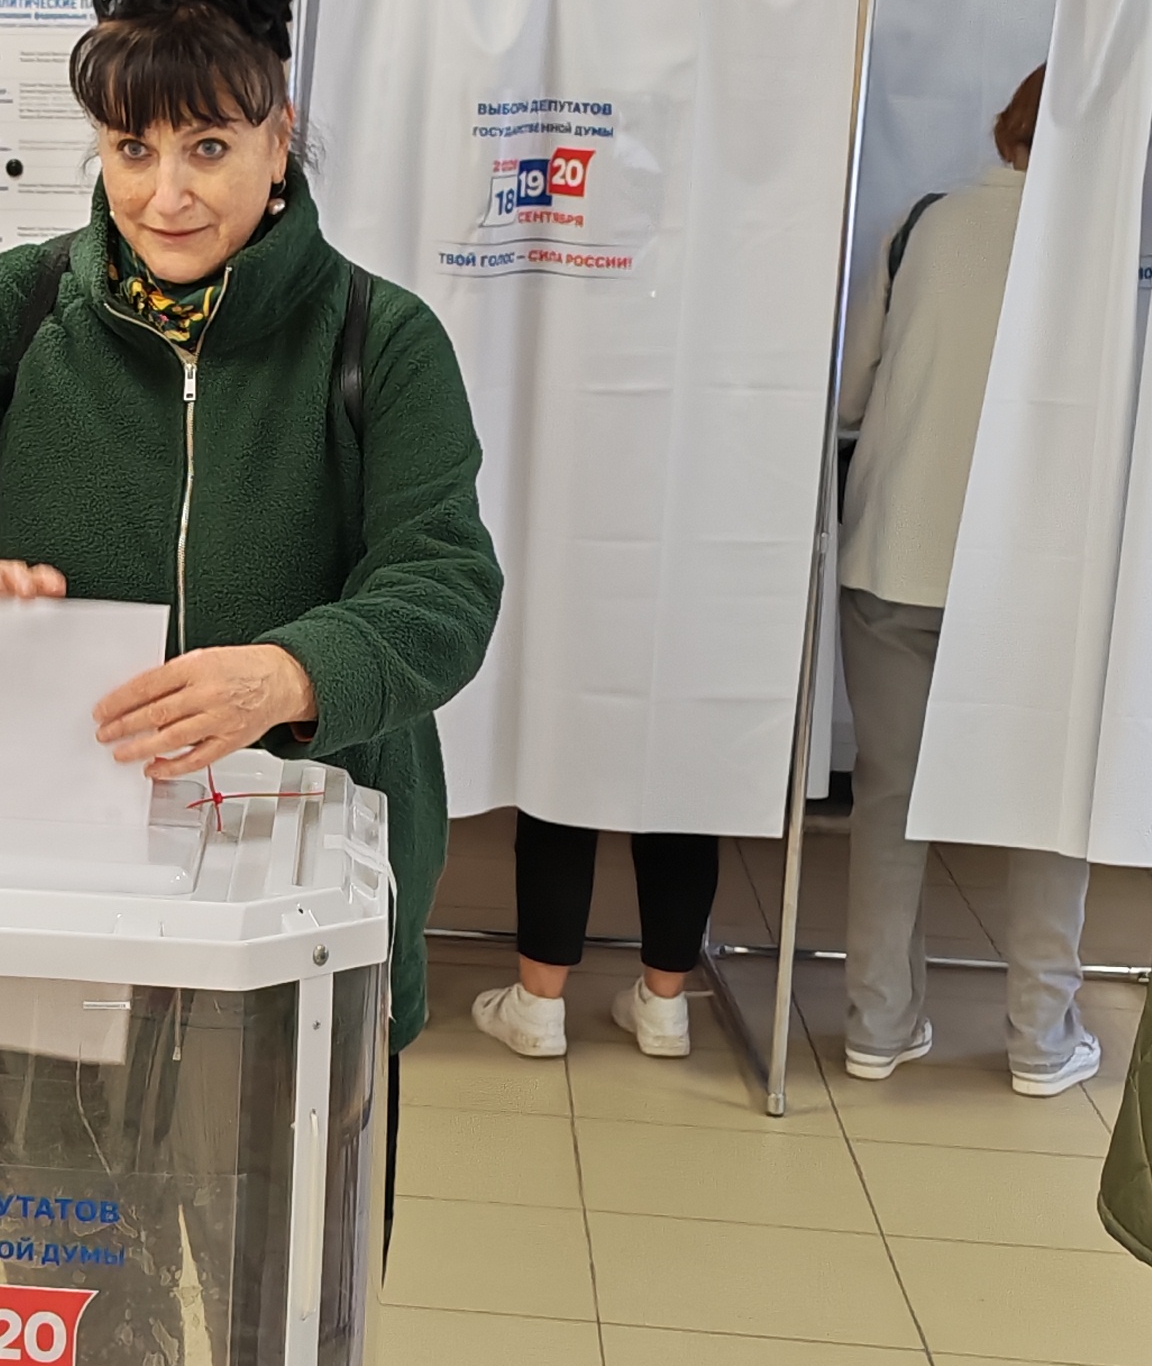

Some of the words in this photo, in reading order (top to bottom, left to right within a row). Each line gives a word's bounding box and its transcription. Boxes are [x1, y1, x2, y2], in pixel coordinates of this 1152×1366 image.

[530, 99, 612, 116] ДЕПУТАТОВ
[573, 125, 614, 138] ДУМЫ
[519, 170, 545, 197] 19
[551, 158, 585, 187] 20
[495, 188, 515, 216] 18
[517, 211, 584, 227] СЕНТЯБРЯ
[439, 251, 476, 267] ТВОЙ
[527, 249, 564, 264] СИЛА
[565, 253, 633, 270] РОССИИ!
[41, 1242, 125, 1267] ДУМЫ
